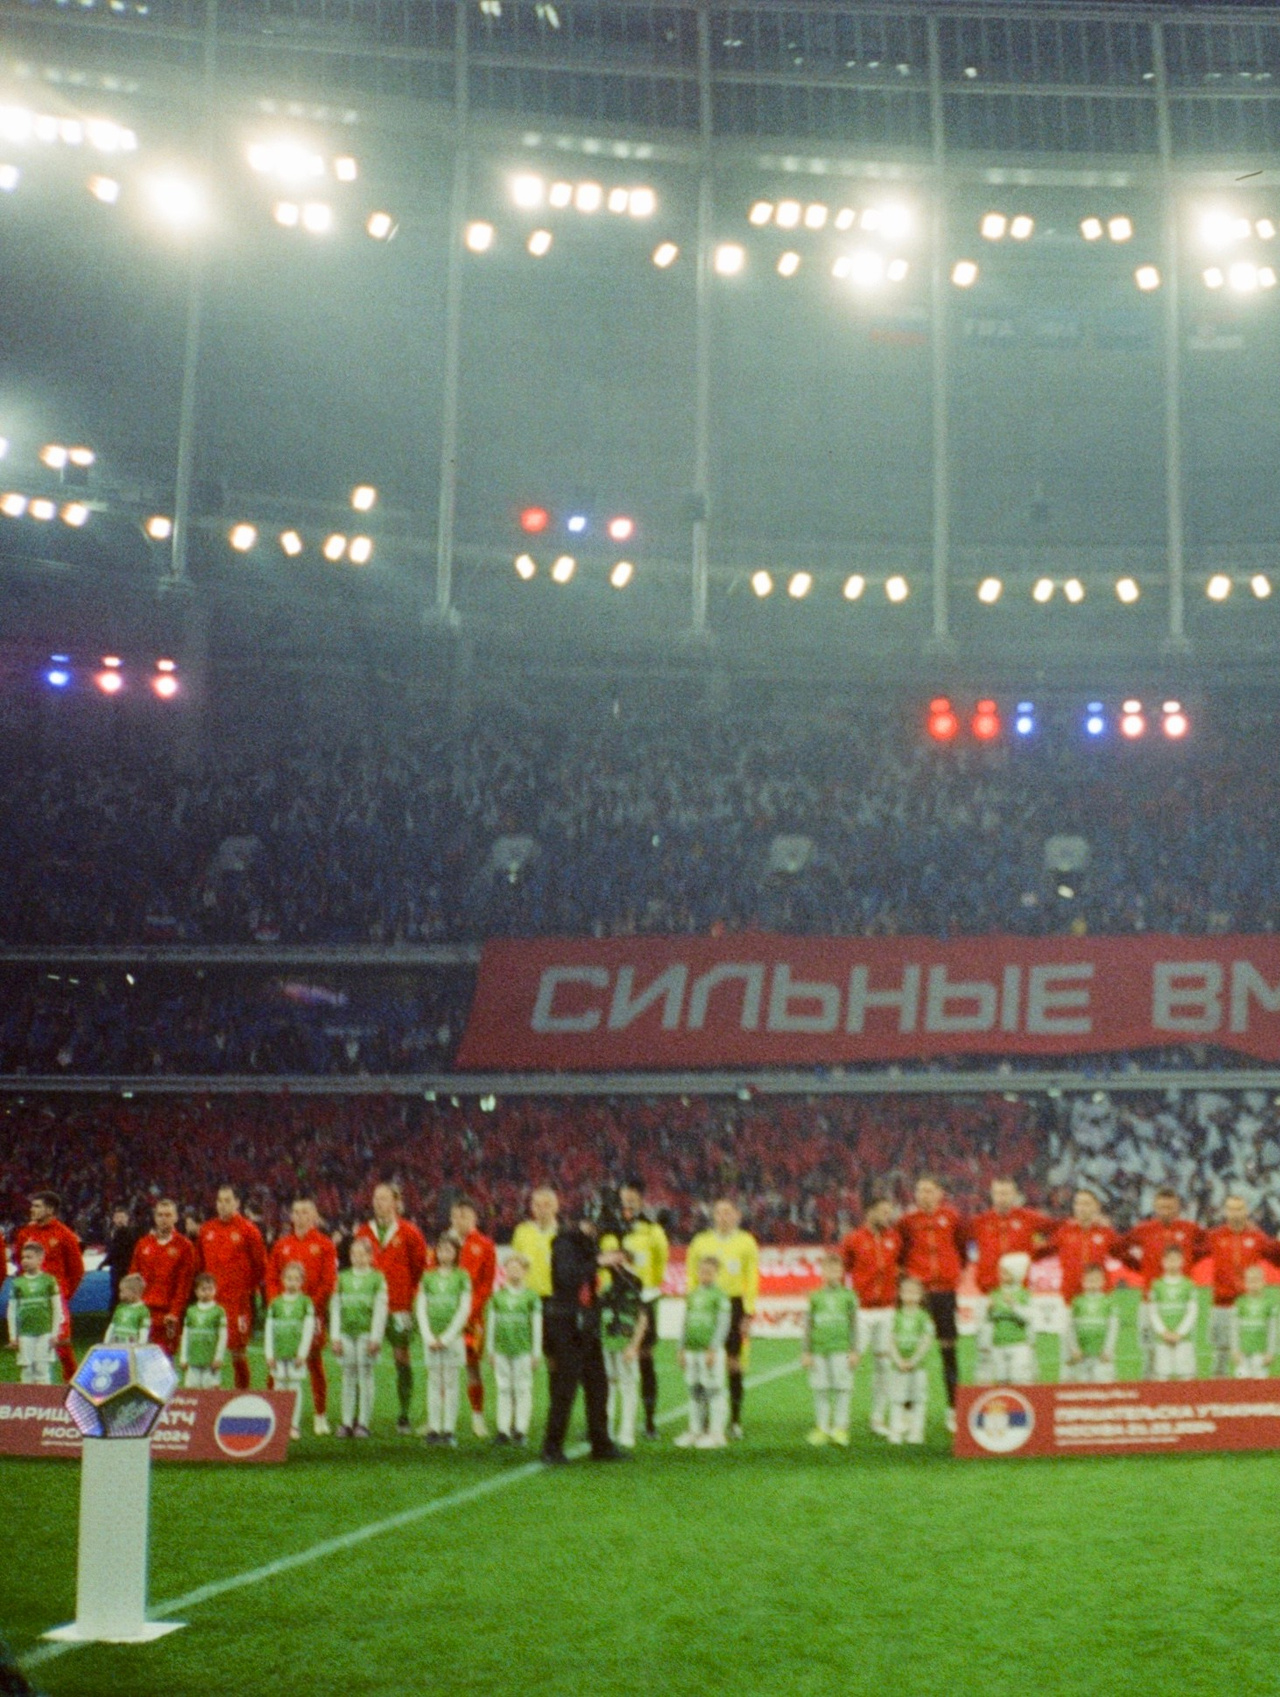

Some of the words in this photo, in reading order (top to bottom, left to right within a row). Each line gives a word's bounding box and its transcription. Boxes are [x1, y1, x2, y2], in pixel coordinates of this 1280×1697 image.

[530, 963, 1096, 1033] СИЛЬНЫЕ
[0, 1405, 72, 1424] ВАРИЩ
[157, 1410, 196, 1426] АТЧ
